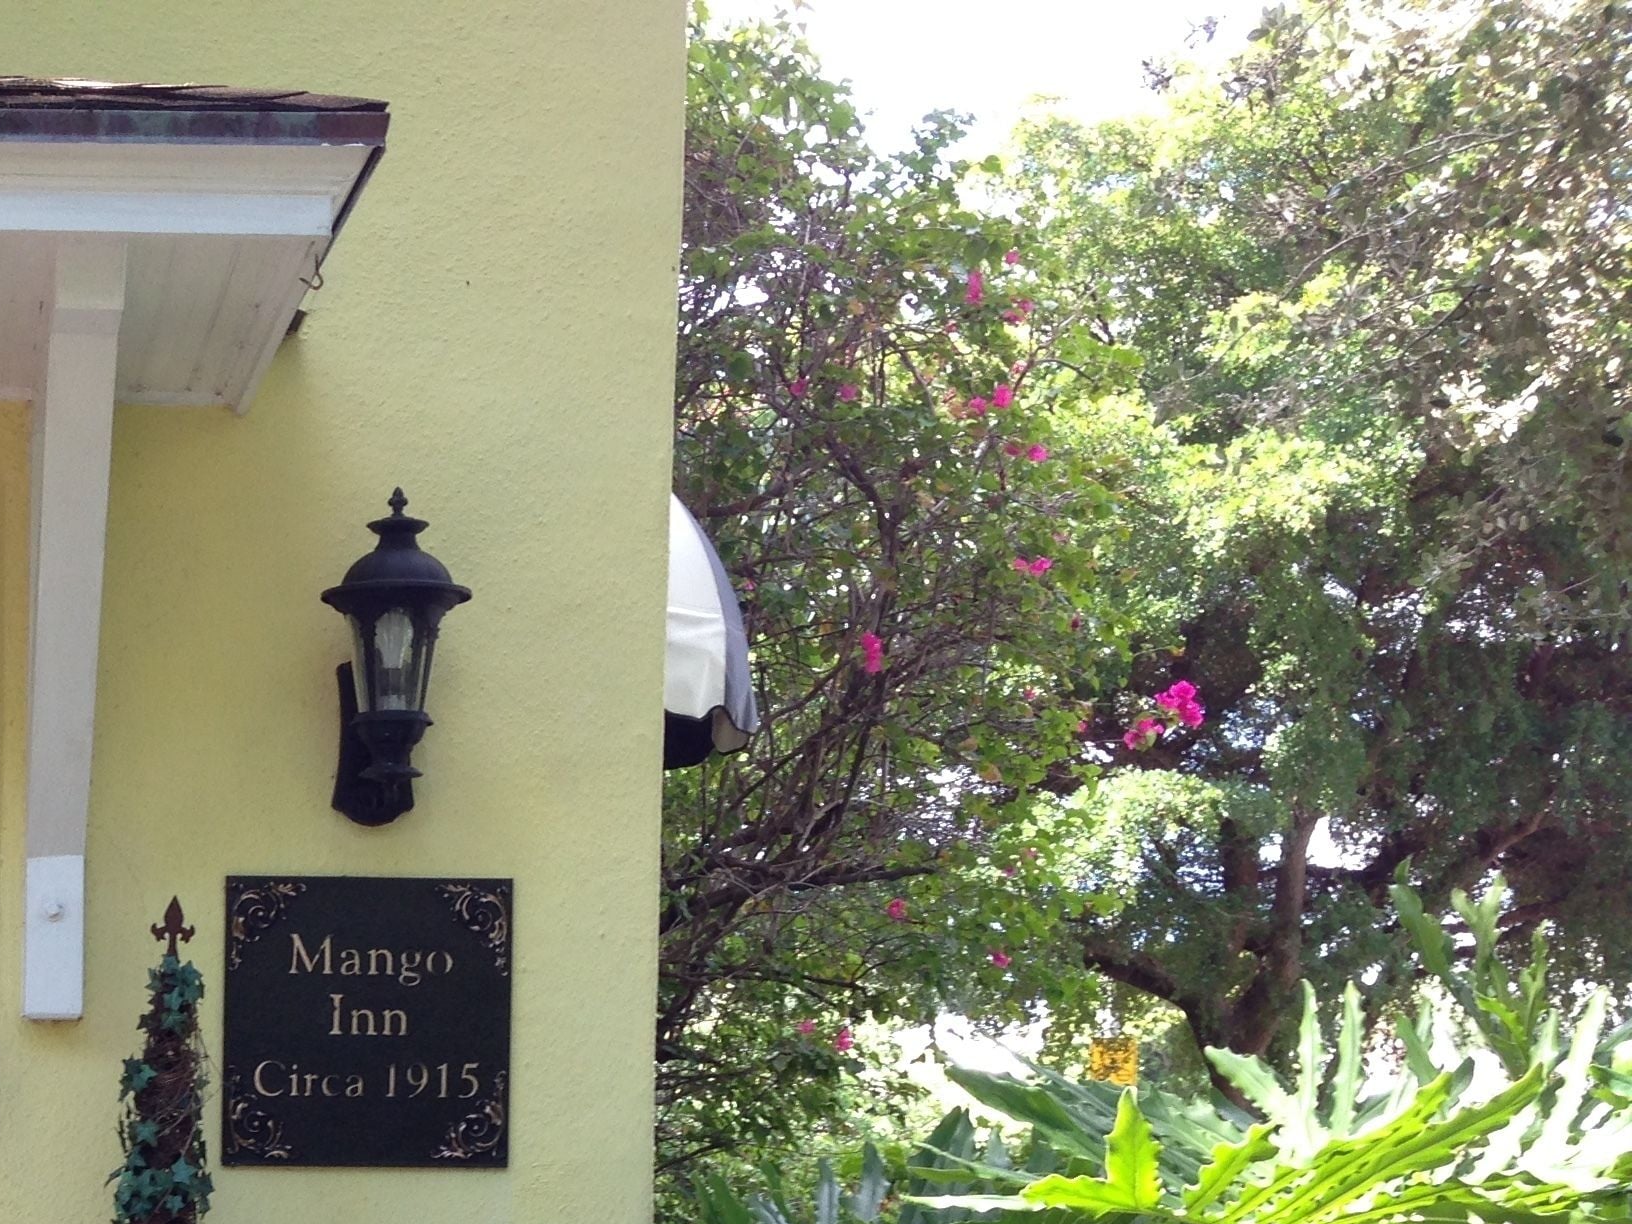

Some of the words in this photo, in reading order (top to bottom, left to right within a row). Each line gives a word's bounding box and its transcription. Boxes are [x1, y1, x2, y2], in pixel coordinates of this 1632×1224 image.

[288, 932, 454, 987] Mango
[328, 993, 410, 1036] Inn
[253, 1059, 365, 1098] Circa
[385, 1061, 481, 1100] 1915
